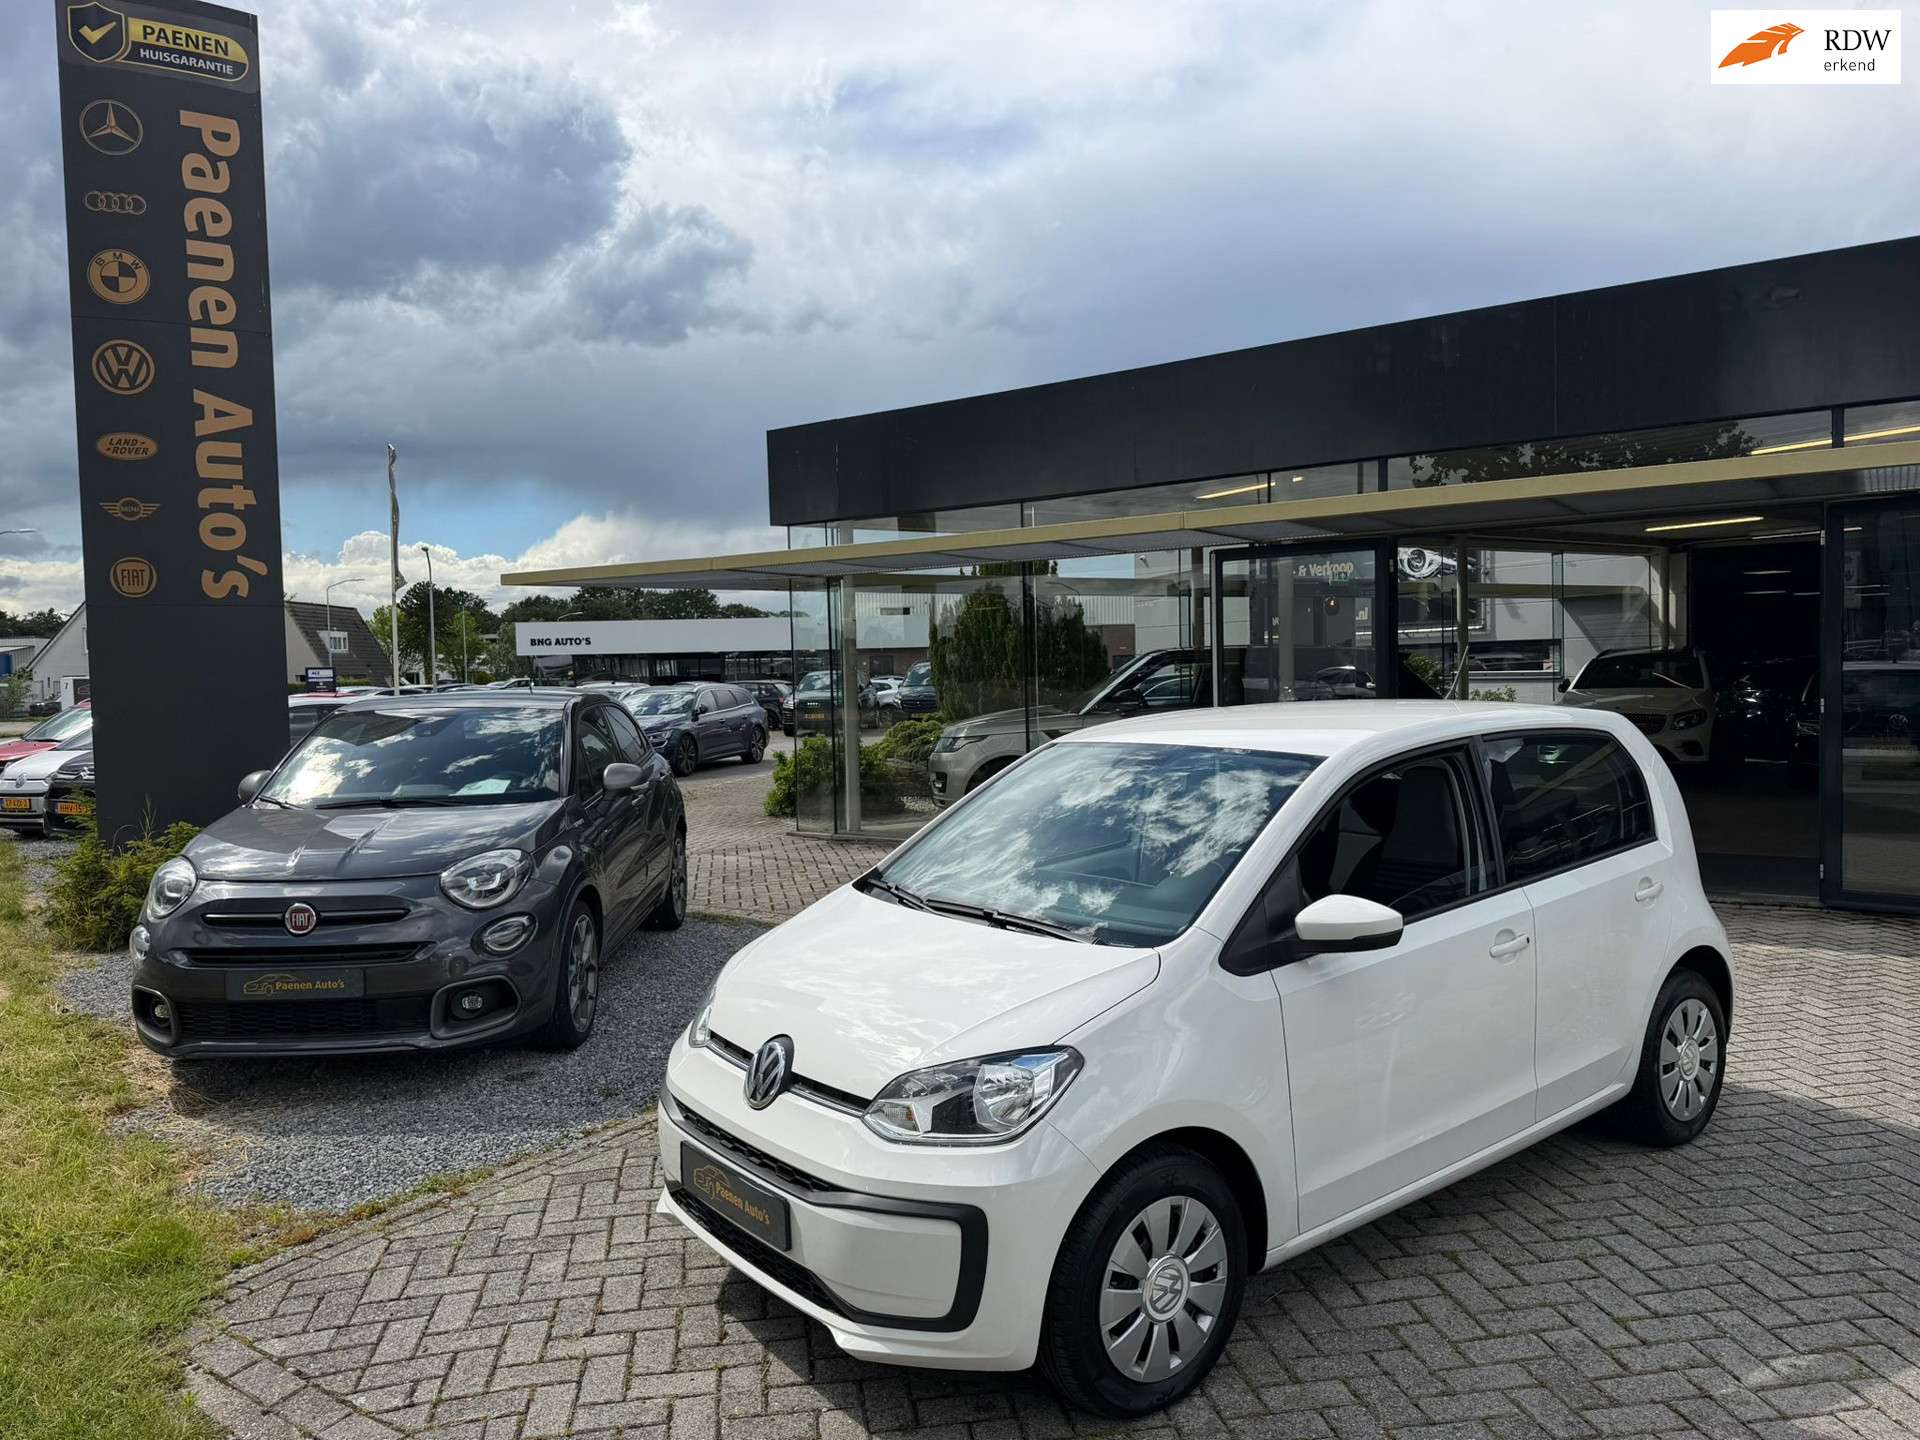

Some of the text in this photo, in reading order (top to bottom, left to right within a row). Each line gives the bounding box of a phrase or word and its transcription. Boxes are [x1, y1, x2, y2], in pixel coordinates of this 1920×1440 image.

[142, 24, 229, 57] PAENEN
[139, 48, 234, 75] HUISGARANTIE
[179, 110, 268, 599] Paenen Auto's
[108, 437, 138, 446] LAND
[111, 446, 149, 455] ROVER
[120, 568, 145, 587] FIAT
[530, 637, 591, 646] BNG AUTO'S
[291, 912, 309, 927] FIAT
[274, 979, 345, 990] Paenen Auto's
